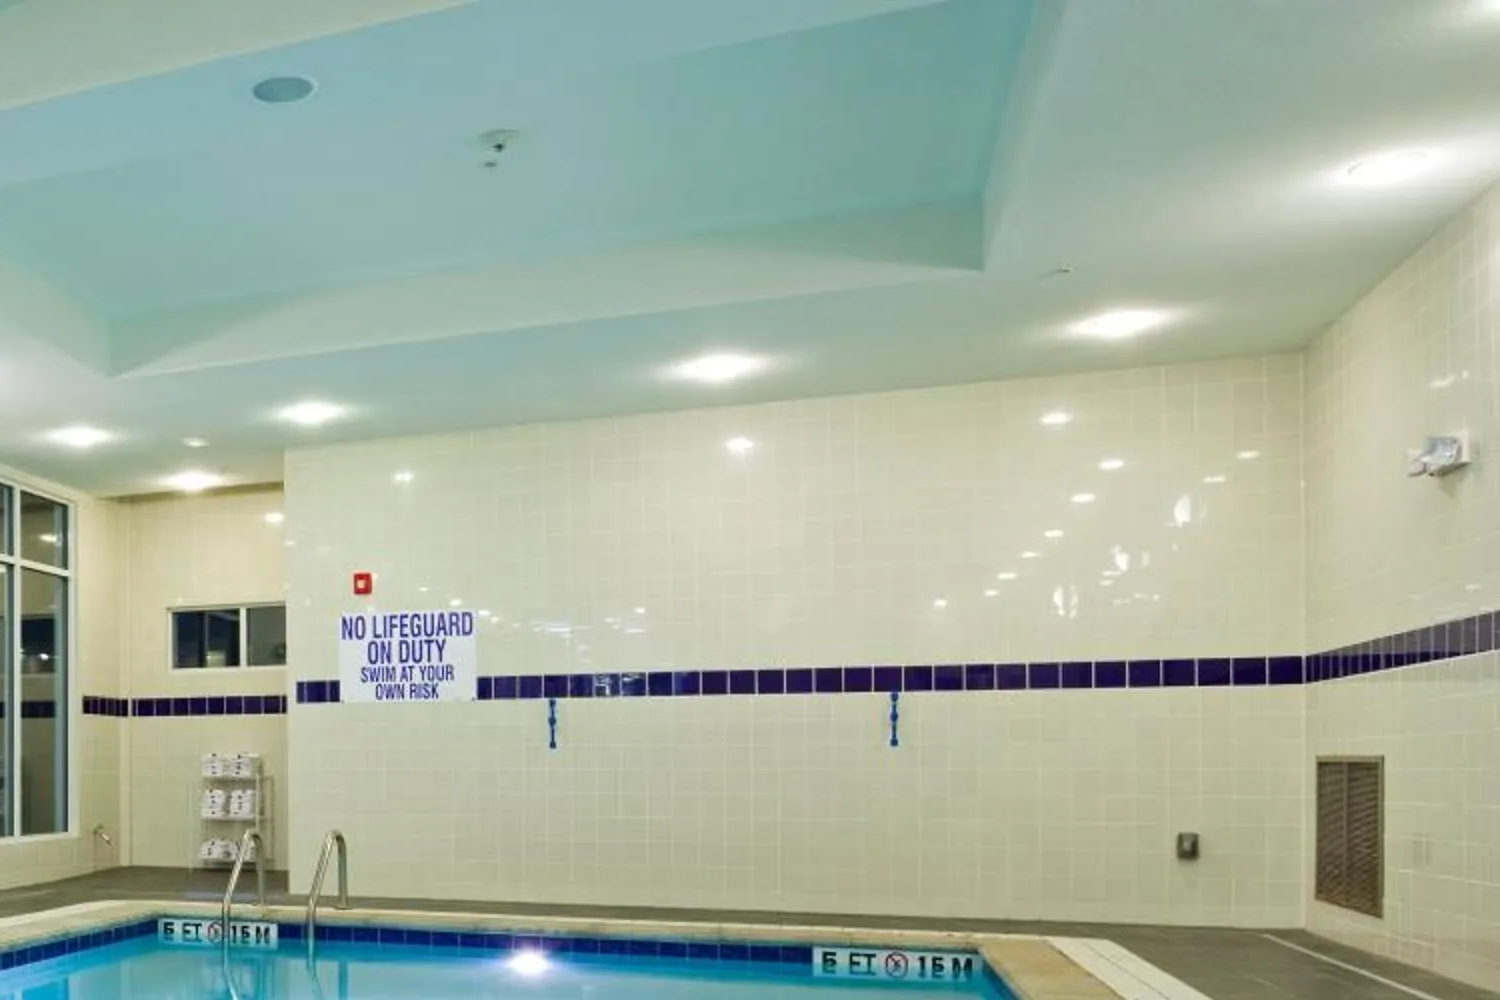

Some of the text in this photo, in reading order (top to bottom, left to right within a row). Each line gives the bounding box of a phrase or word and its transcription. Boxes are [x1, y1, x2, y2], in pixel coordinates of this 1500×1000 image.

[341, 612, 473, 640] NO LIFEGUARD
[367, 638, 446, 664] ON DUTY
[360, 664, 454, 683] SWIM AT YOUR
[375, 682, 439, 700] OWN RISK
[850, 953, 876, 968] FT
